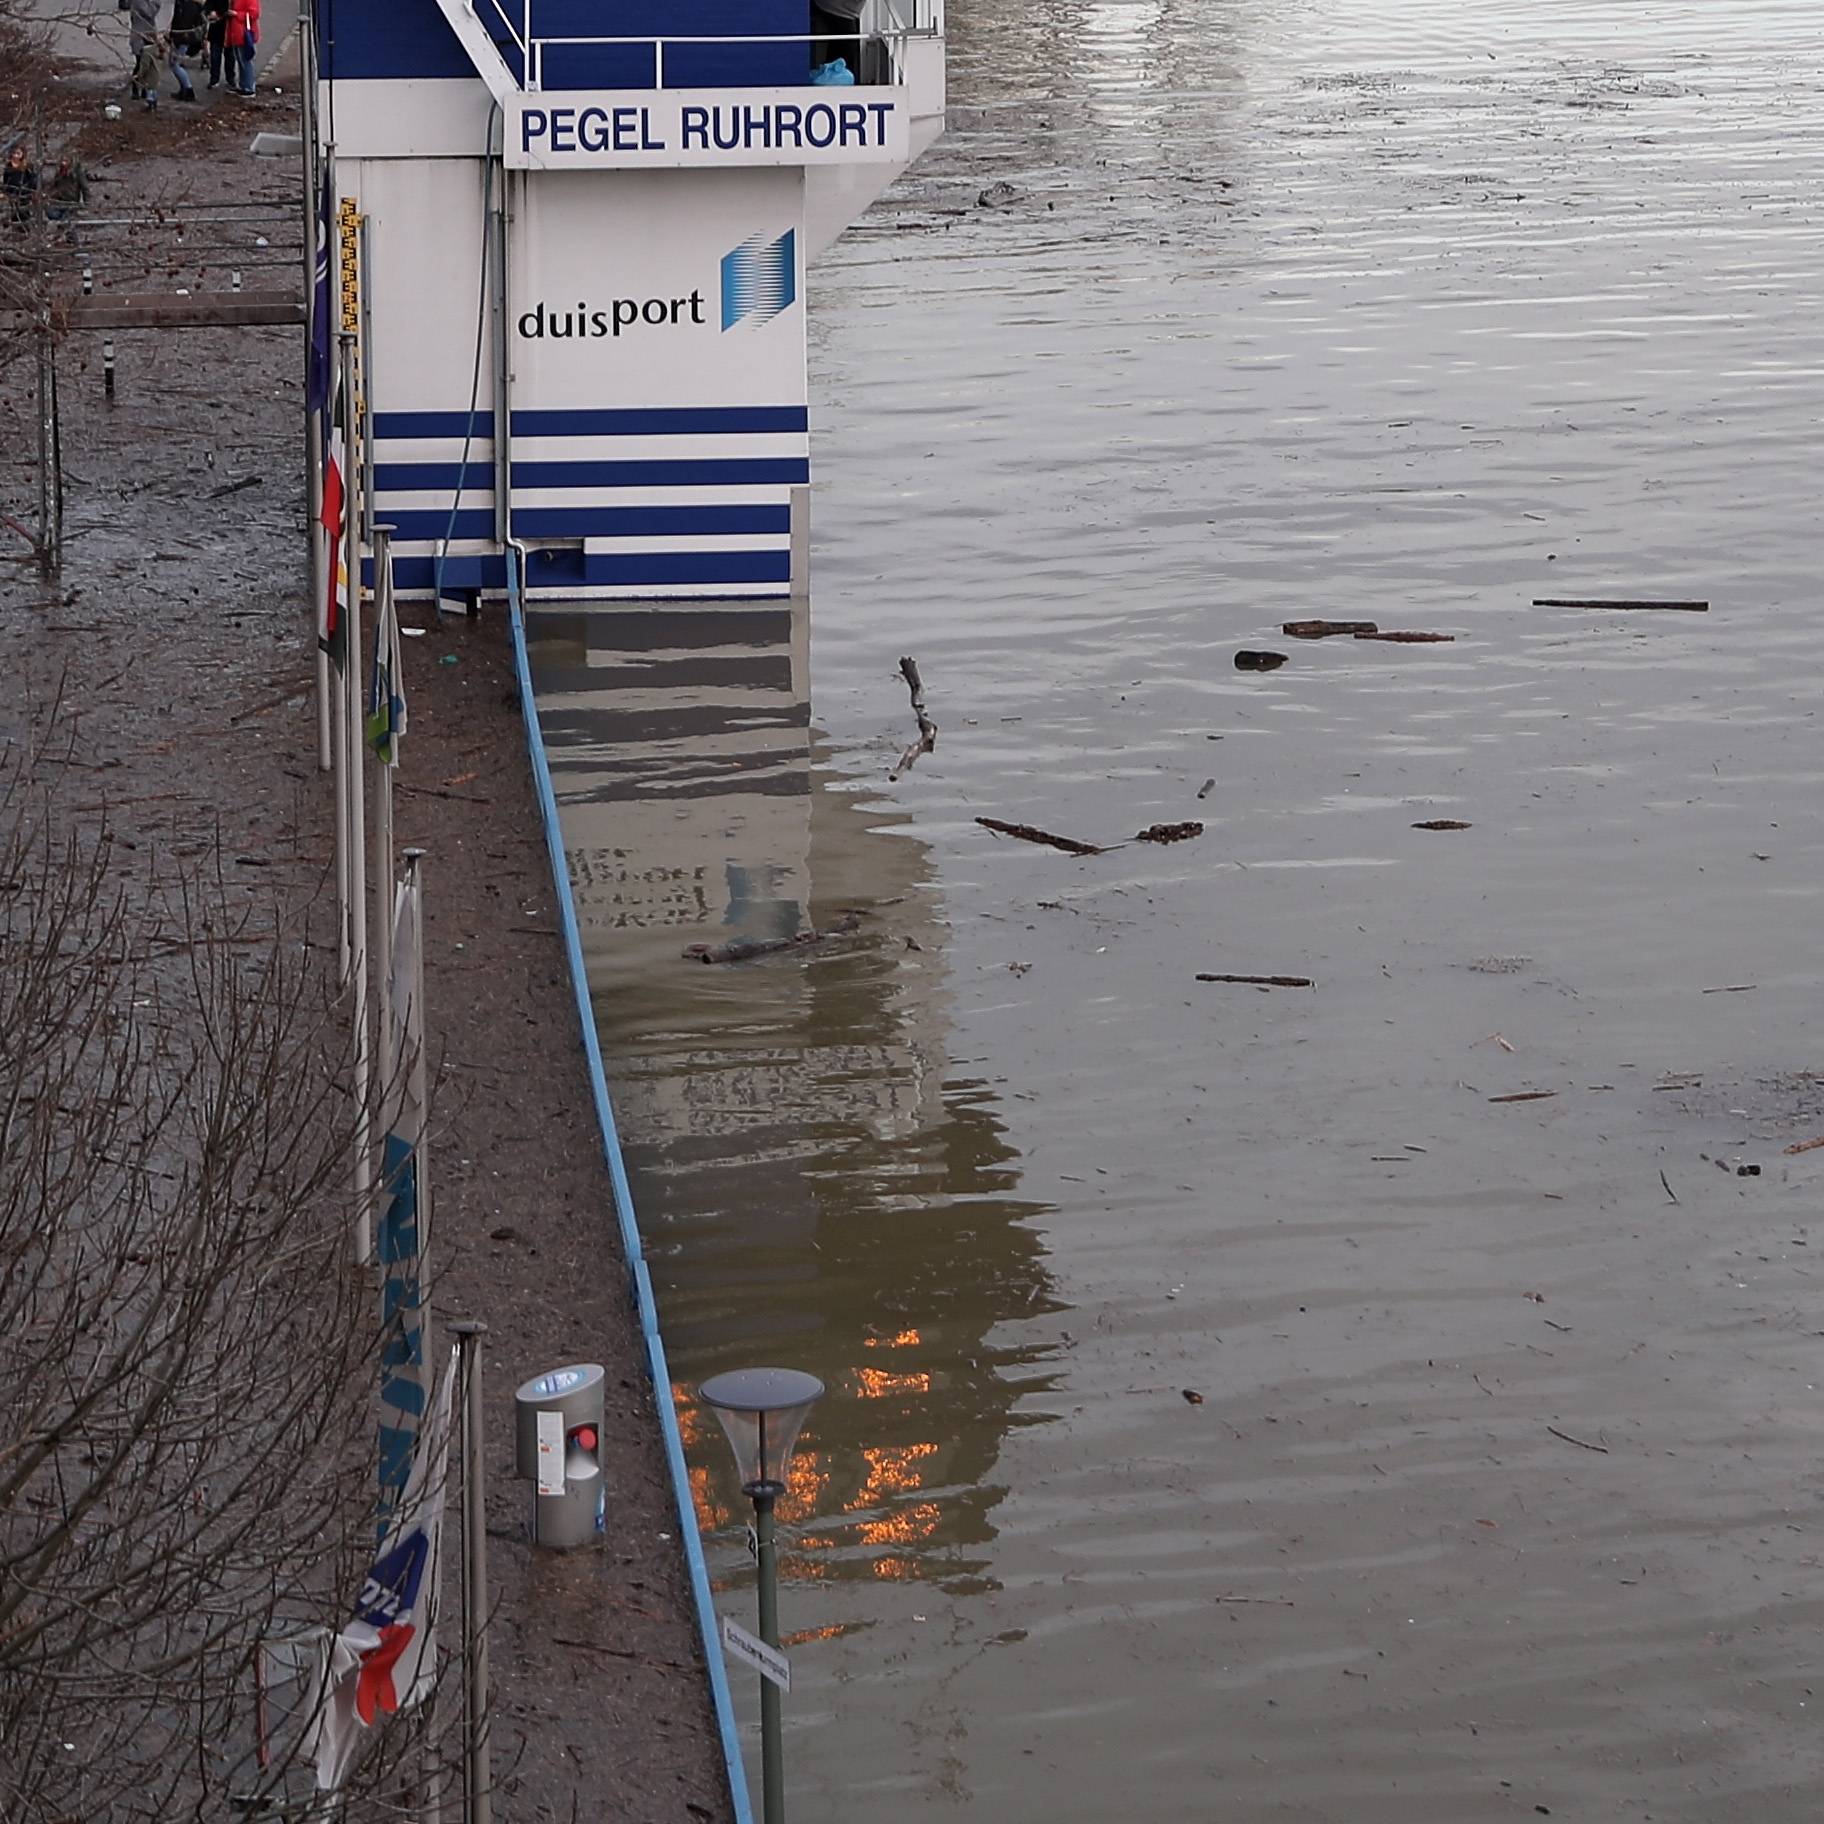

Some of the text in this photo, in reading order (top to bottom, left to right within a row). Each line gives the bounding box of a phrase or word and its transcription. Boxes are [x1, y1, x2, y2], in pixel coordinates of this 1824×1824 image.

[521, 102, 895, 153] PEGEL RUHRORT
[517, 287, 705, 339] duisport
